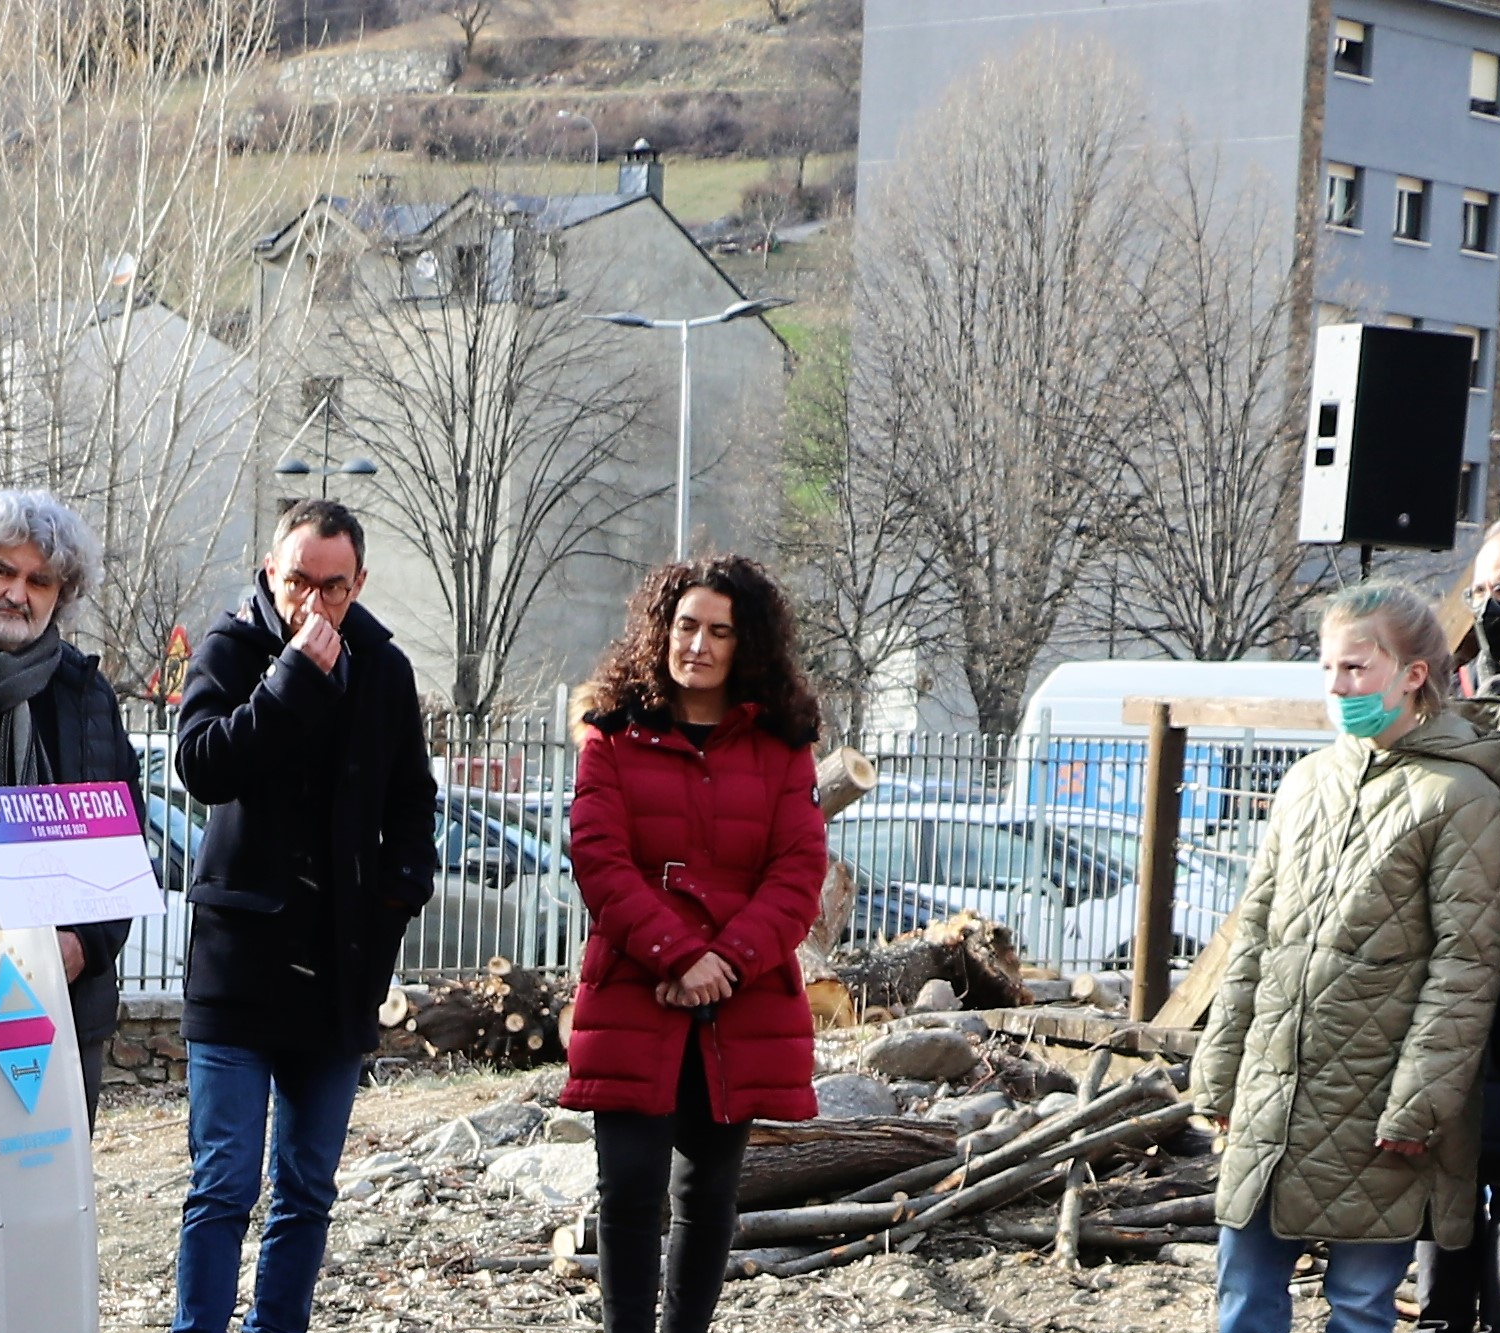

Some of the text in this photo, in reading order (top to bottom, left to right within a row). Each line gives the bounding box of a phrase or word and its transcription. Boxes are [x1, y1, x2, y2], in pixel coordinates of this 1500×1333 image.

[70, 788, 127, 820] PEDRA
[31, 826, 38, 838] 9
[37, 825, 47, 837] DE
[63, 824, 74, 836] DE
[73, 823, 89, 836] 2022
